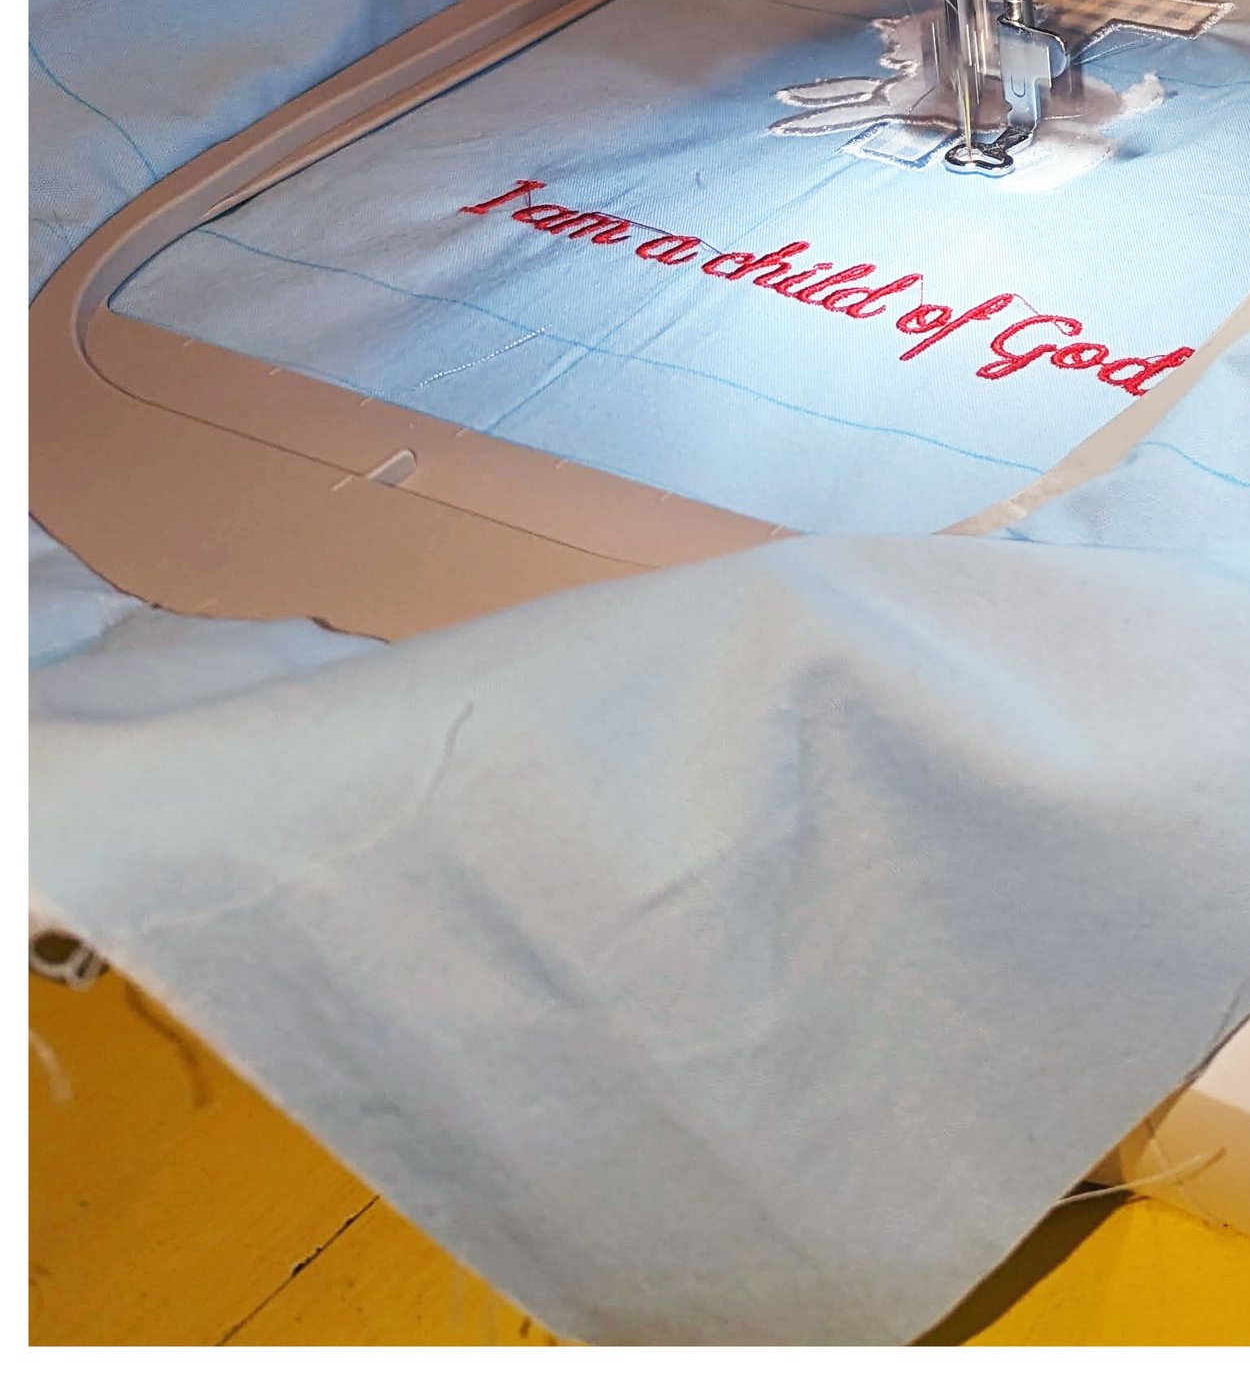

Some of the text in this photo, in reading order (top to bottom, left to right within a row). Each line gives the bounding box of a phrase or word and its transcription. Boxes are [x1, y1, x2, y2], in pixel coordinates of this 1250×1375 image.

[458, 179, 1196, 397] I am a child of God
